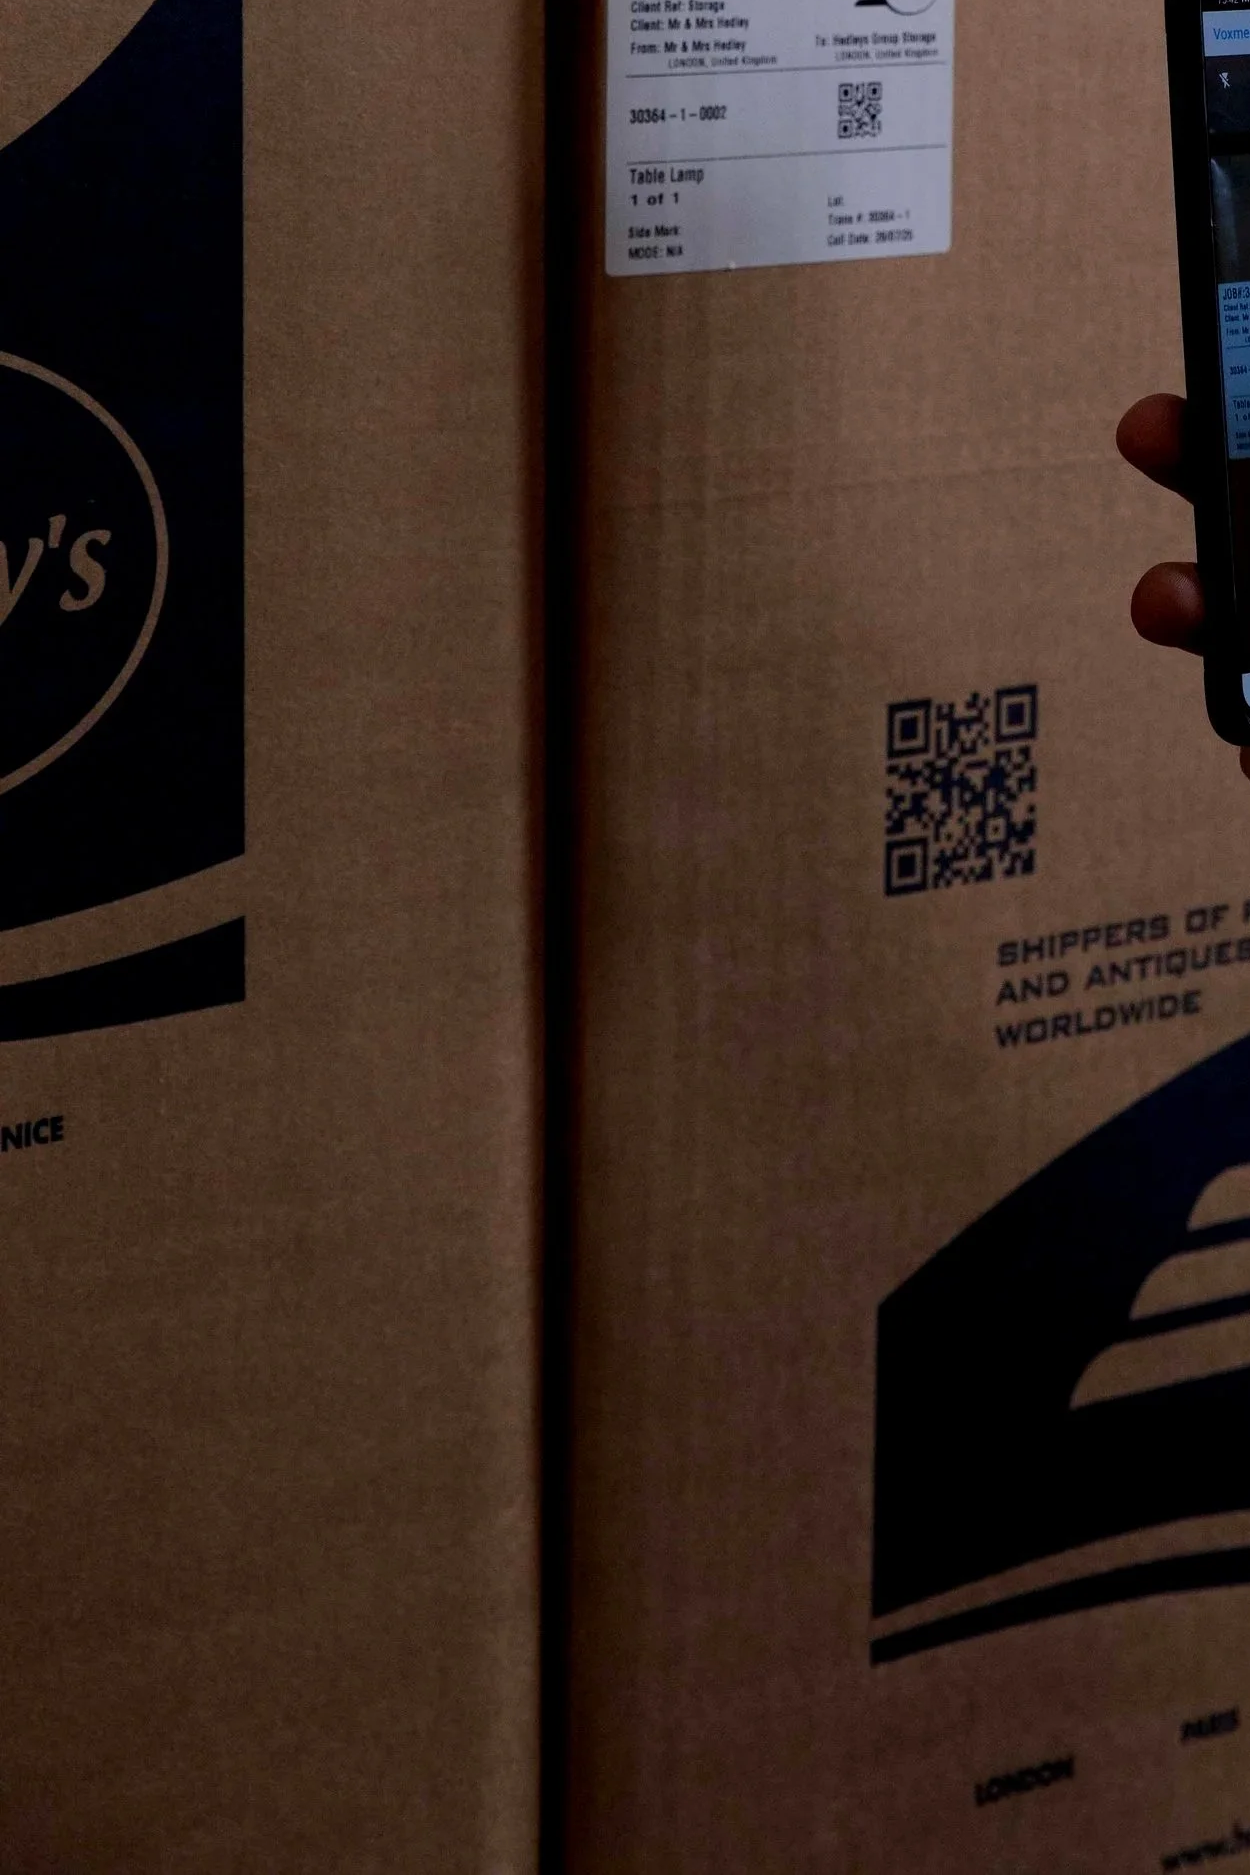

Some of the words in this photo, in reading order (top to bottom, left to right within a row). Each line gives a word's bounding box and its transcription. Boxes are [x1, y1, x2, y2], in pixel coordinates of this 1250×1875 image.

[630, 0, 661, 13] Client
[688, 0, 725, 13] Storage
[668, 18, 681, 30] Mr
[685, 18, 691, 30] &
[695, 18, 713, 29] Mrs
[717, 17, 749, 31] Hedley
[664, 42, 677, 53] Mr
[681, 42, 688, 53] &
[692, 41, 710, 52] Mrs
[713, 40, 746, 54] Hedley
[629, 168, 665, 186] Table
[670, 167, 704, 185] Lamp
[631, 194, 638, 207] 1
[647, 193, 664, 206] of
[673, 192, 679, 204] 1
[628, 226, 650, 239] Side
[996, 912, 1171, 967] SHIPPERS
[1185, 904, 1230, 933] OF
[996, 970, 1070, 1006] AND
[995, 989, 1202, 1048] WORLDWIDE
[1, 1115, 64, 1152] NICE
[975, 1756, 1074, 1807] LONDON
